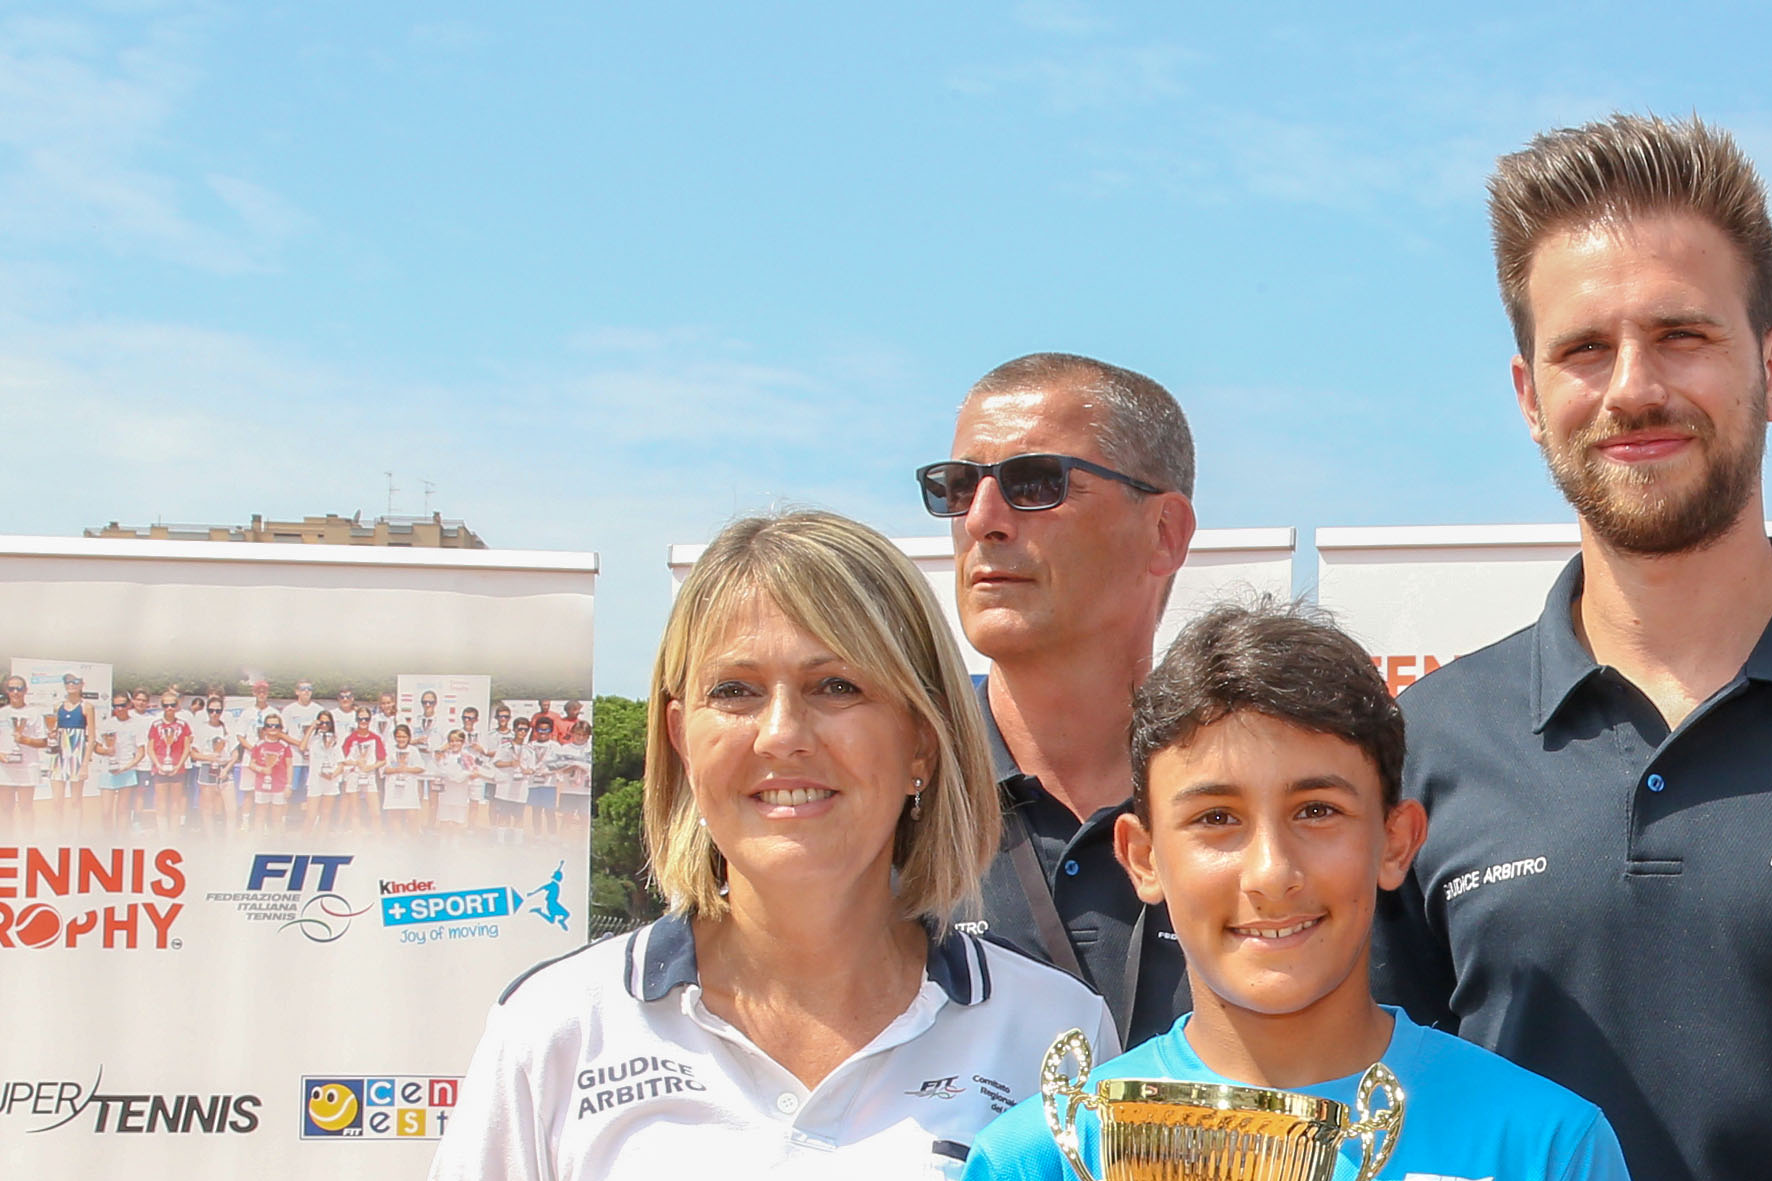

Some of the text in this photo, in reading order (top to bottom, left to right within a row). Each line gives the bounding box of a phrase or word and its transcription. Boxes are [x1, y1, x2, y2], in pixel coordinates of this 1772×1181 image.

[246, 854, 353, 891] FIT
[1483, 857, 1547, 884] ARBITRO
[206, 893, 300, 901] FEDERAZIONE
[237, 903, 297, 911] ITALIANA
[246, 913, 296, 921] TENNIS
[400, 923, 498, 944] Joy of moving
[577, 1056, 695, 1090] GIUDICE
[578, 1076, 707, 1120] ARBITRO
